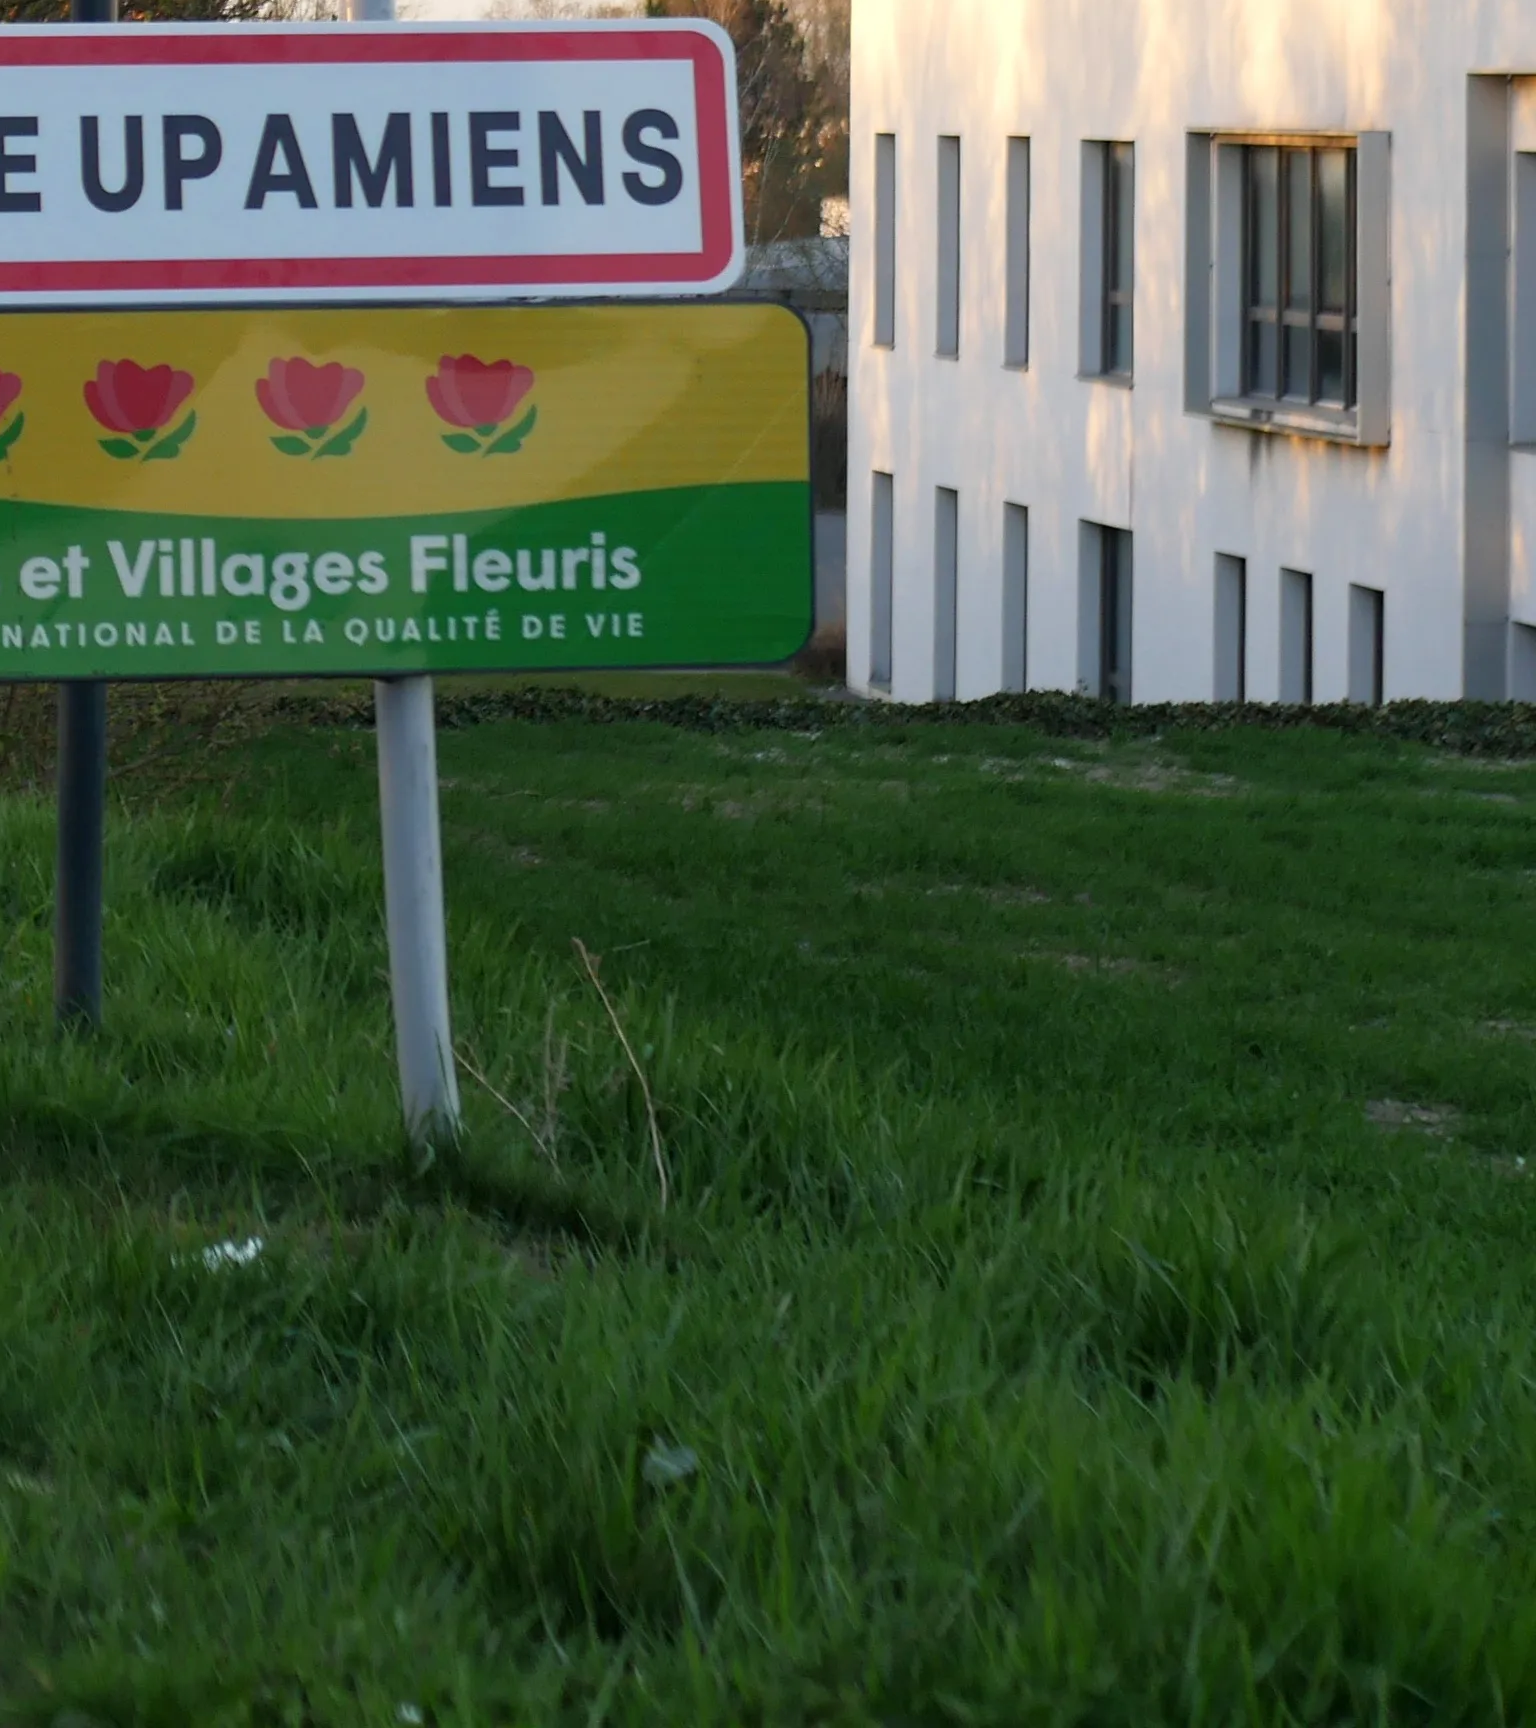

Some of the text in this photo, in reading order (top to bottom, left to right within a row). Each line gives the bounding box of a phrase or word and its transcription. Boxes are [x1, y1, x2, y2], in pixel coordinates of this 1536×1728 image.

[243, 108, 684, 210] AMIENS
[19, 544, 90, 600] et
[106, 537, 389, 611] Villages
[409, 531, 641, 594] Fleuris
[1, 621, 195, 648] NATIONAL
[216, 620, 261, 645] DE
[282, 618, 324, 644] LA
[343, 609, 502, 645] QUALITÉ
[522, 614, 566, 639] DE
[585, 612, 643, 638] VIE
